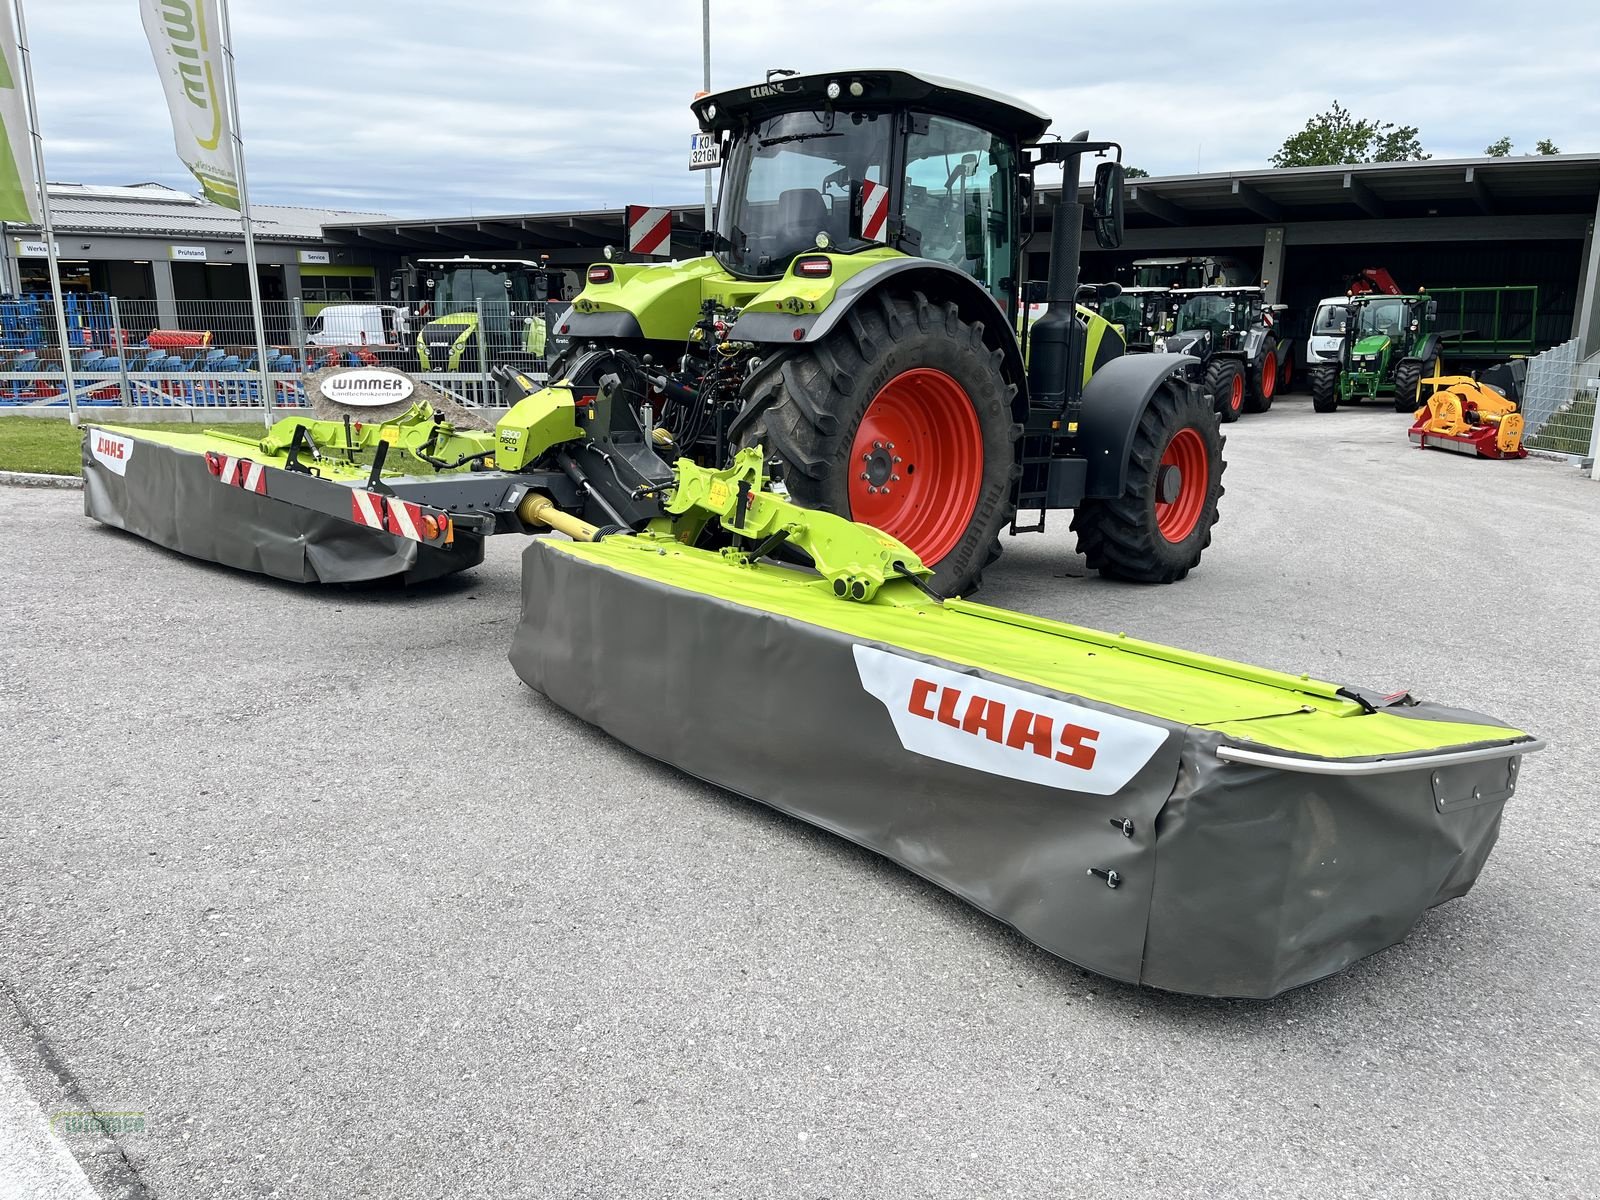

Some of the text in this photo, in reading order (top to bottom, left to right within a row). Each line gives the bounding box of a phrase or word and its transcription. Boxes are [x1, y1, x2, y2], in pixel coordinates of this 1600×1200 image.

[750, 83, 784, 98] CLAAS
[700, 136, 709, 150] KO
[692, 149, 717, 163] 321GN
[332, 379, 403, 390] WIMMER
[500, 436, 517, 445] DISCO
[97, 437, 124, 460] CLAAS
[952, 483, 1005, 578] TRELLEBORG
[907, 678, 1100, 771] CLAAS
